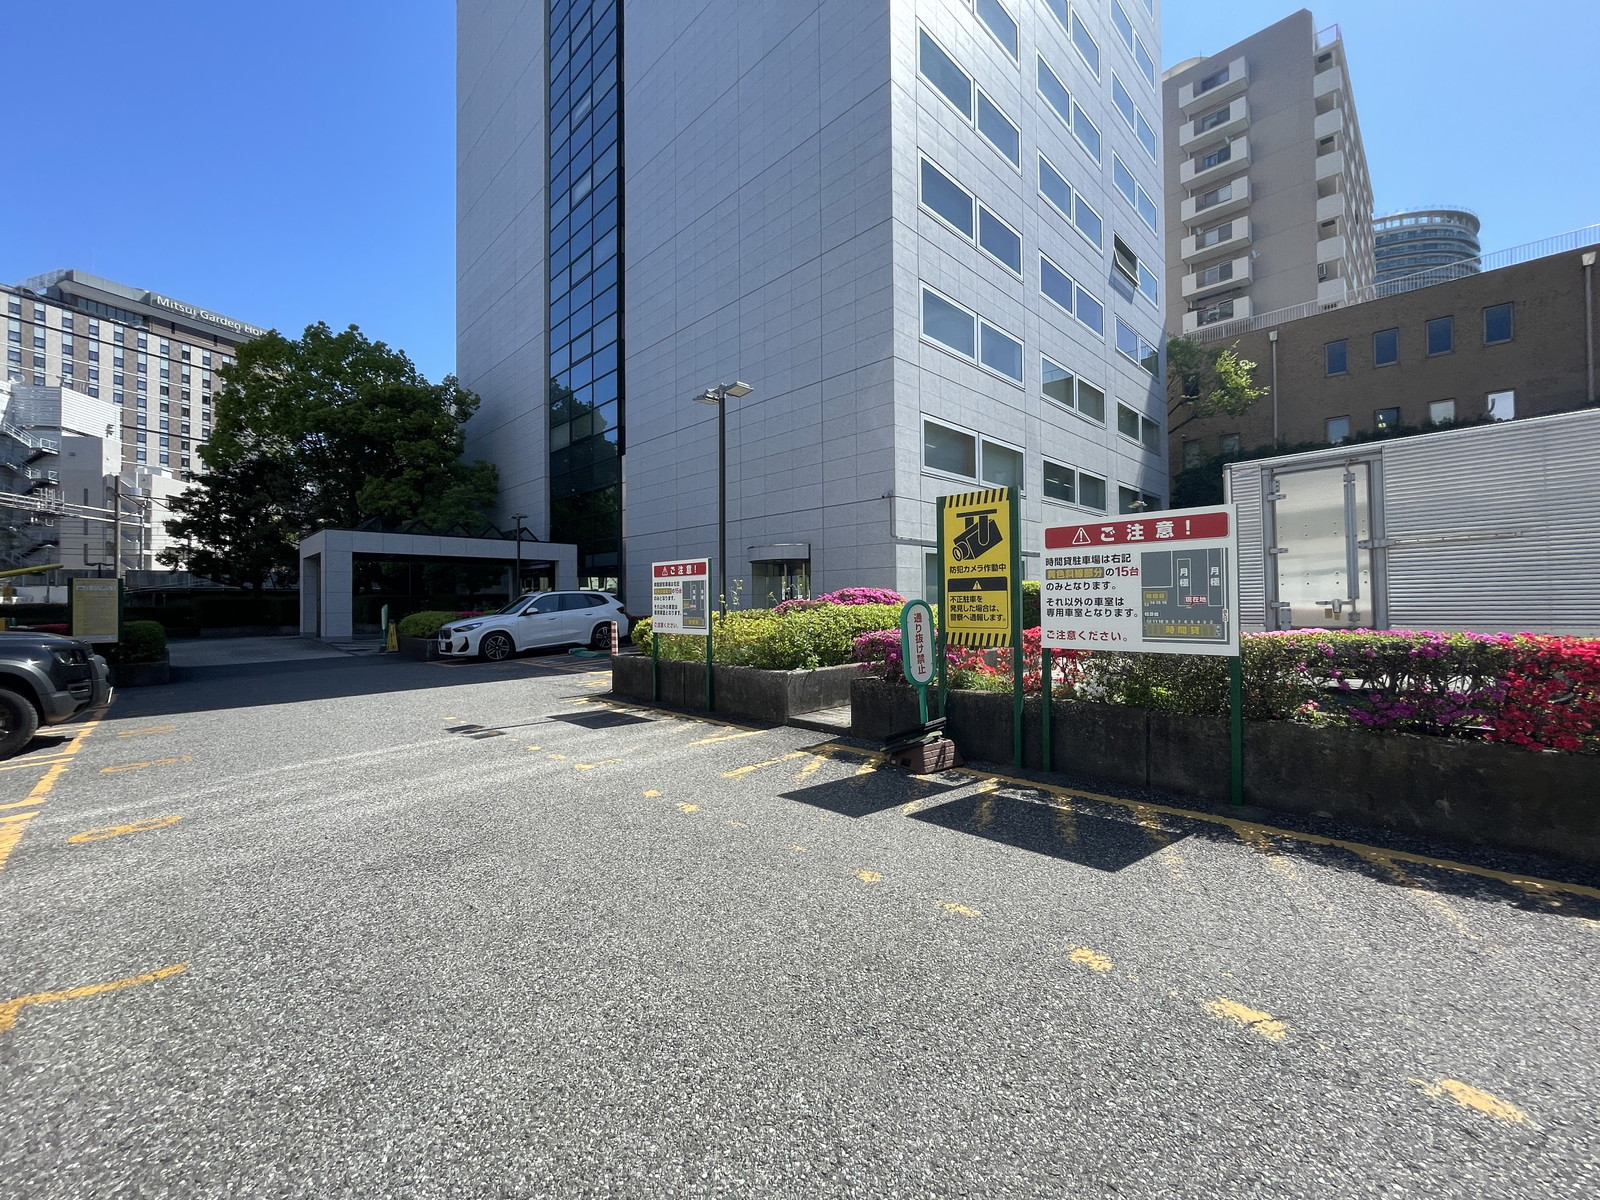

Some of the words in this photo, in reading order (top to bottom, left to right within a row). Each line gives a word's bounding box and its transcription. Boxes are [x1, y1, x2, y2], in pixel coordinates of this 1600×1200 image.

[156, 295, 196, 316] Mitsui
[200, 310, 241, 330] Garden
[1100, 519, 1191, 541] ご注意！
[1045, 553, 1132, 567] 時間貸駐車場は右記
[949, 563, 1007, 574] 防犯カメラ作動中
[1045, 581, 1116, 592] のみとなります。
[949, 595, 983, 603] 不正駐車を
[1046, 597, 1125, 607] それ以外の車室は
[950, 604, 1000, 613] 発見した場合は、
[1046, 608, 1138, 618] 専用車室となります。
[950, 613, 1006, 621] 警察へ通報します。
[1046, 629, 1128, 642] ご注意ください。
[913, 612, 927, 675] 通り抜け禁止
